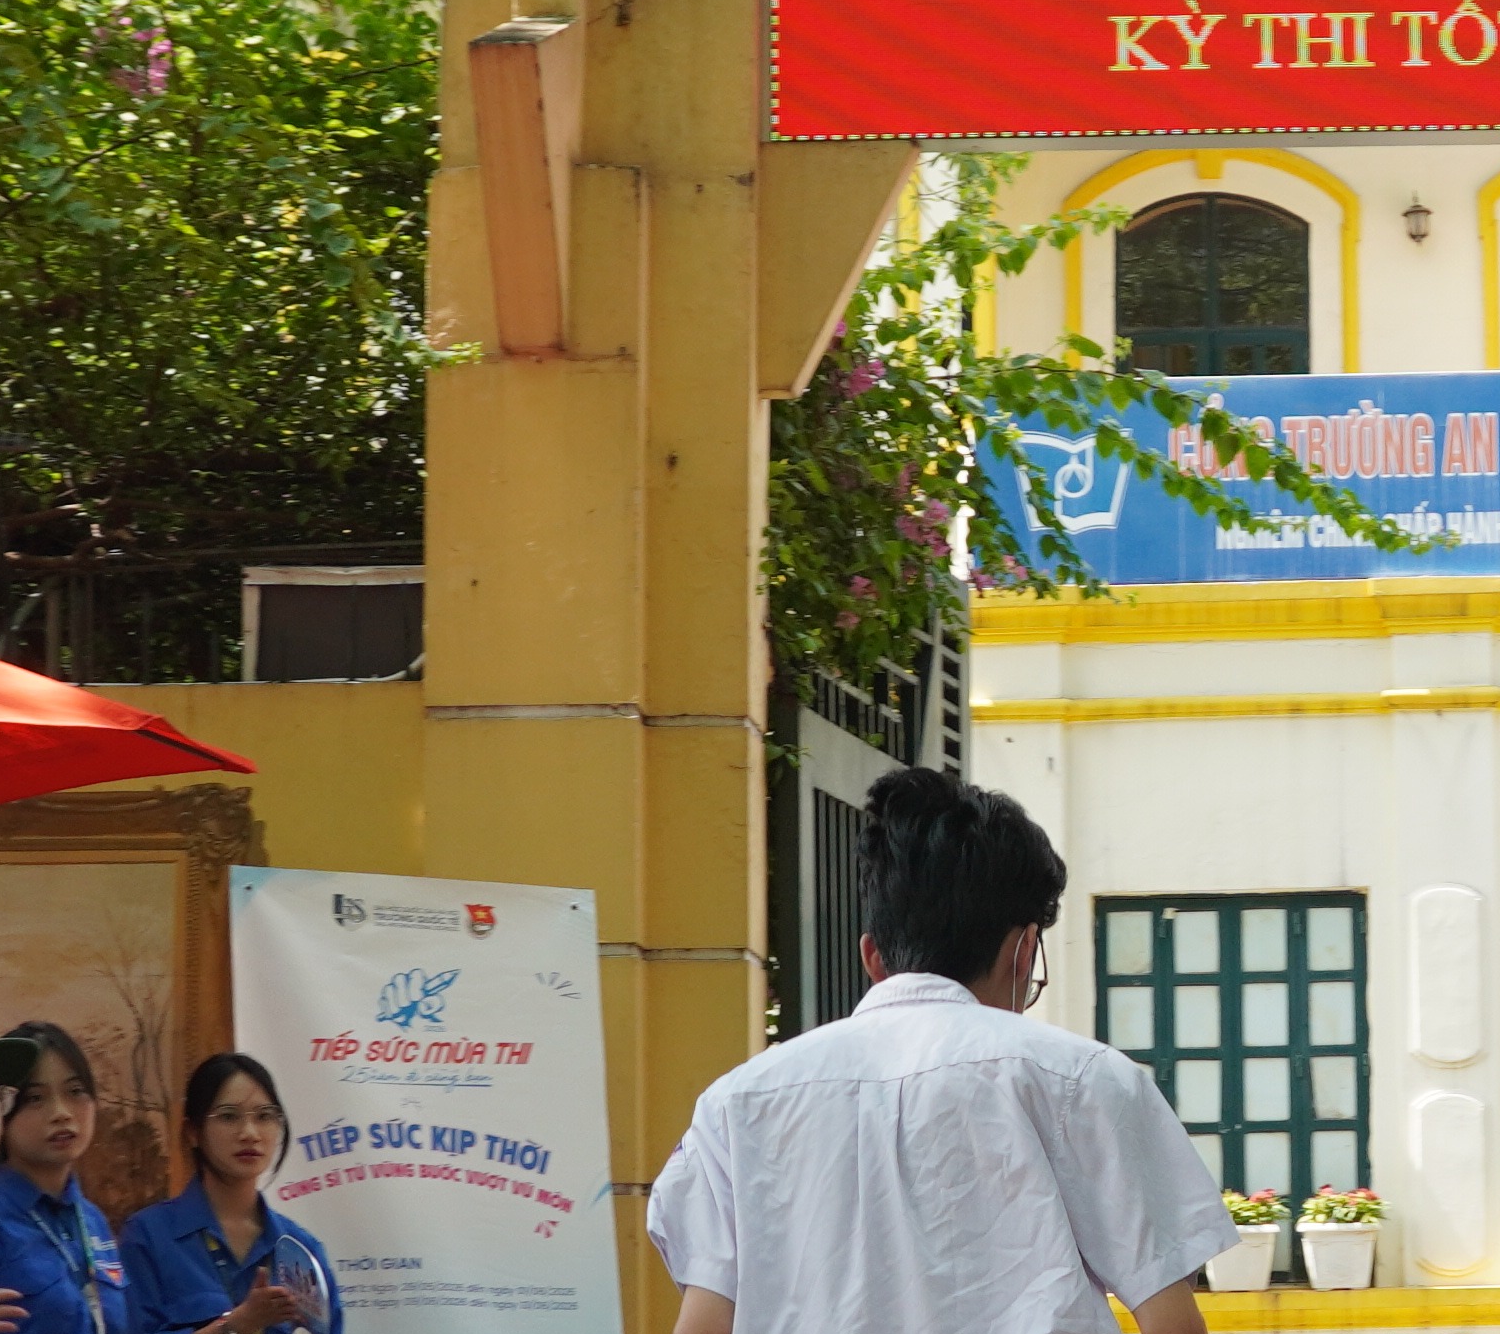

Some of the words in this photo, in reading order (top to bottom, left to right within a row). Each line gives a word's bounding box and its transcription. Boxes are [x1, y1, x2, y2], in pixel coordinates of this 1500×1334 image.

[1241, 10, 1376, 71] THI
[1281, 400, 1436, 480] TRƯỜNG
[1441, 411, 1499, 476] AN
[309, 1030, 360, 1062] TIẾP
[365, 1035, 419, 1063] SỨC
[494, 1041, 535, 1065] THI
[297, 1117, 360, 1162] TIẾP
[368, 1118, 423, 1150] SỨC
[430, 1124, 478, 1157] KỊP
[484, 1133, 552, 1175] THỜI
